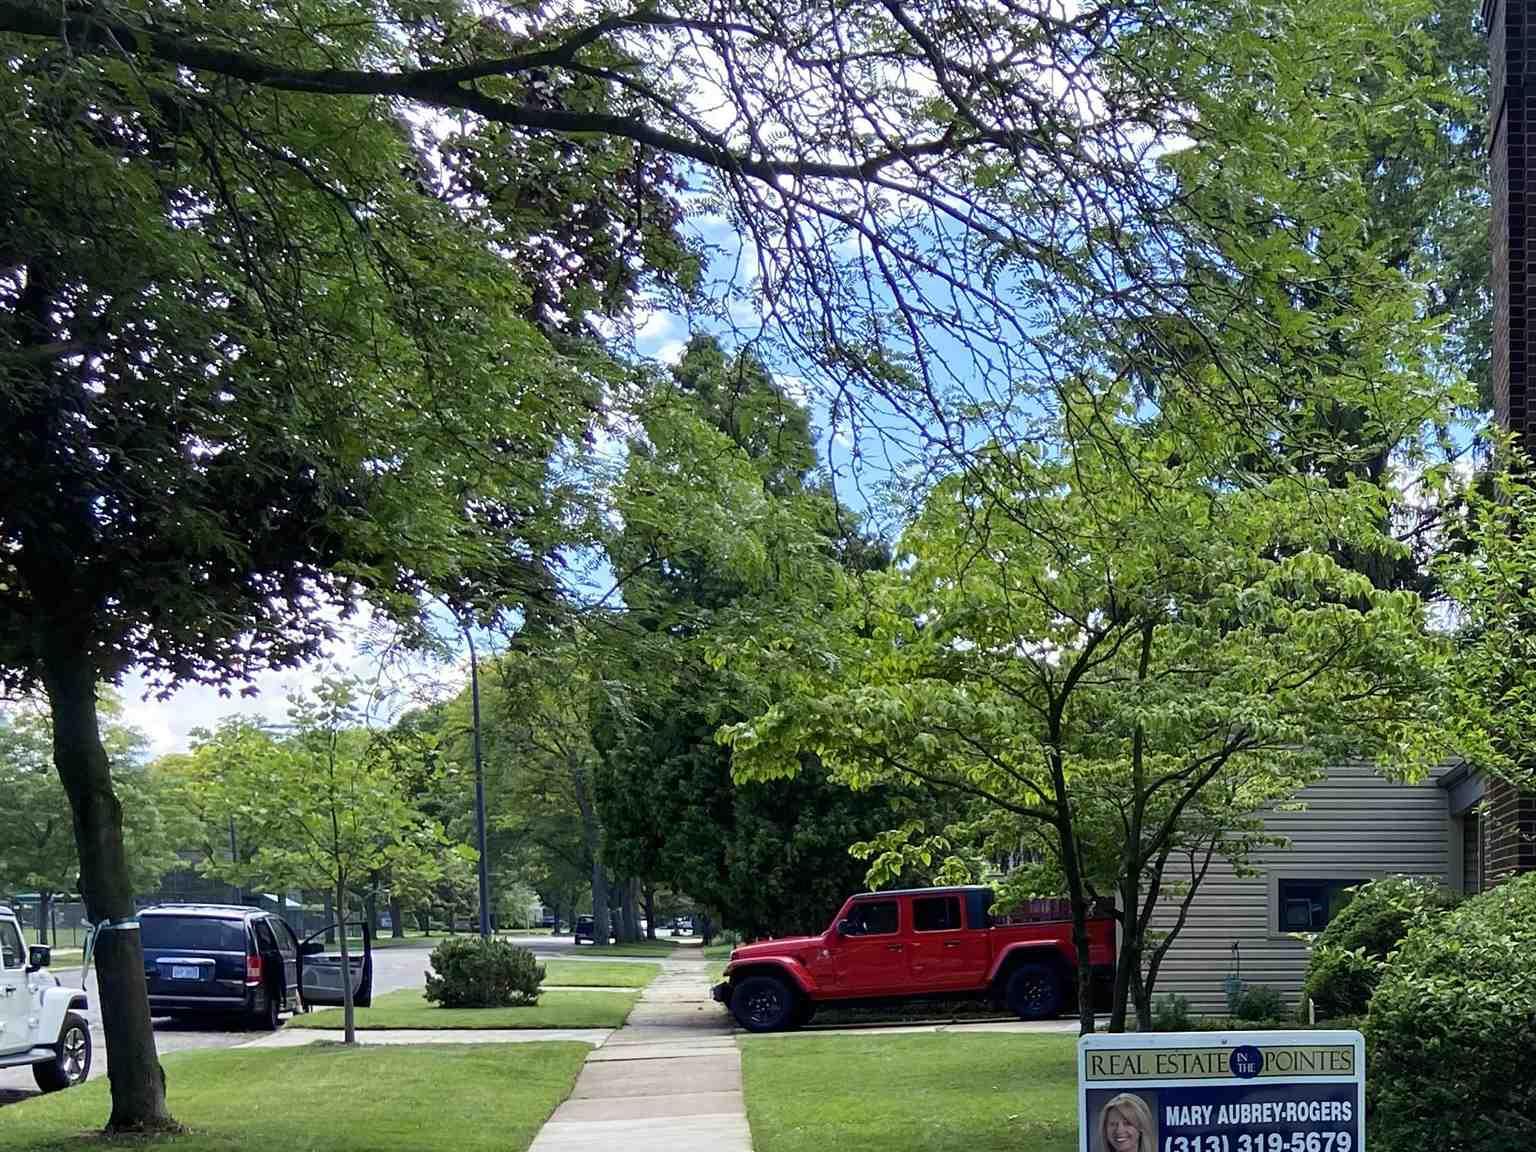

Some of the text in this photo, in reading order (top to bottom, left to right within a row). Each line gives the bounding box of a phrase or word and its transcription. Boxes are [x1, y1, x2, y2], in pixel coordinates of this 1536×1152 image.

[1091, 1053, 1229, 1076] REAL ESTATE
[1237, 1053, 1249, 1062] IN
[1237, 1062, 1257, 1073] THE
[1265, 1050, 1352, 1072] POINTES
[1166, 1101, 1352, 1126] MARY AUBREY-ROGERS
